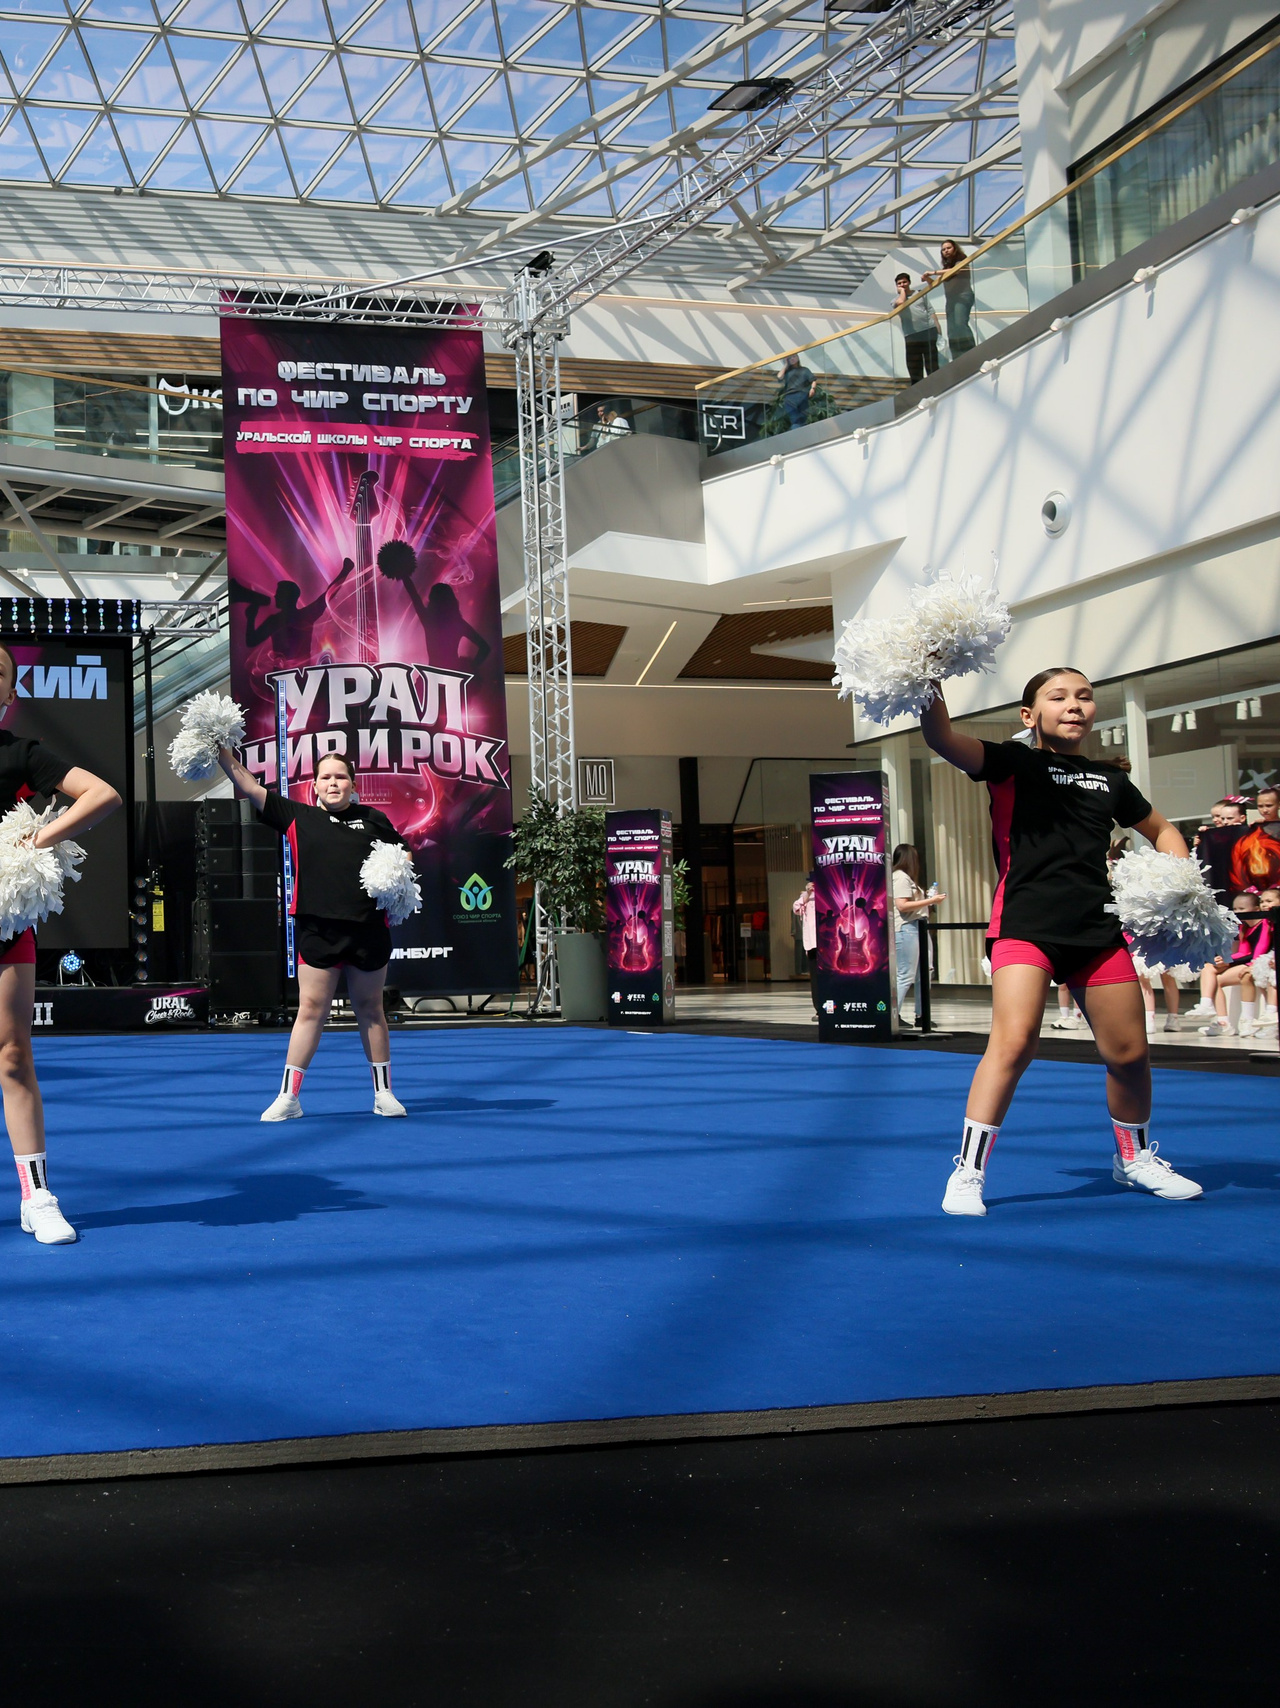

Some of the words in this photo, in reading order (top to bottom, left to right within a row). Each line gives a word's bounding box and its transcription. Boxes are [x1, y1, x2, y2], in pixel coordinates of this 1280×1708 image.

[277, 361, 447, 386] ФЕСТИВАЛЬ
[237, 388, 278, 407] ПО
[291, 390, 349, 408] ЧИР
[362, 392, 473, 414] СПОРТУ
[236, 431, 312, 444] УРАЛЬСКОЙ
[317, 434, 367, 446] ШКОЛЫ
[373, 436, 402, 447] ЧИР
[409, 436, 472, 450] СПОРТА
[272, 667, 465, 733] УРАЛ
[358, 729, 390, 768] И
[400, 729, 499, 783] РОК
[586, 765, 607, 795] MO
[848, 803, 882, 811] СПОРТУ
[823, 836, 876, 853] УРАЛ
[615, 861, 654, 874] УРАЛ
[818, 852, 844, 866] ЧИР
[845, 852, 853, 862] И
[856, 852, 883, 865] РОК
[609, 874, 630, 884] ЧИР
[639, 874, 660, 884] РОК
[390, 947, 453, 960] ИНБУРГ
[151, 997, 189, 1010] URAL
[31, 1003, 53, 1025] II
